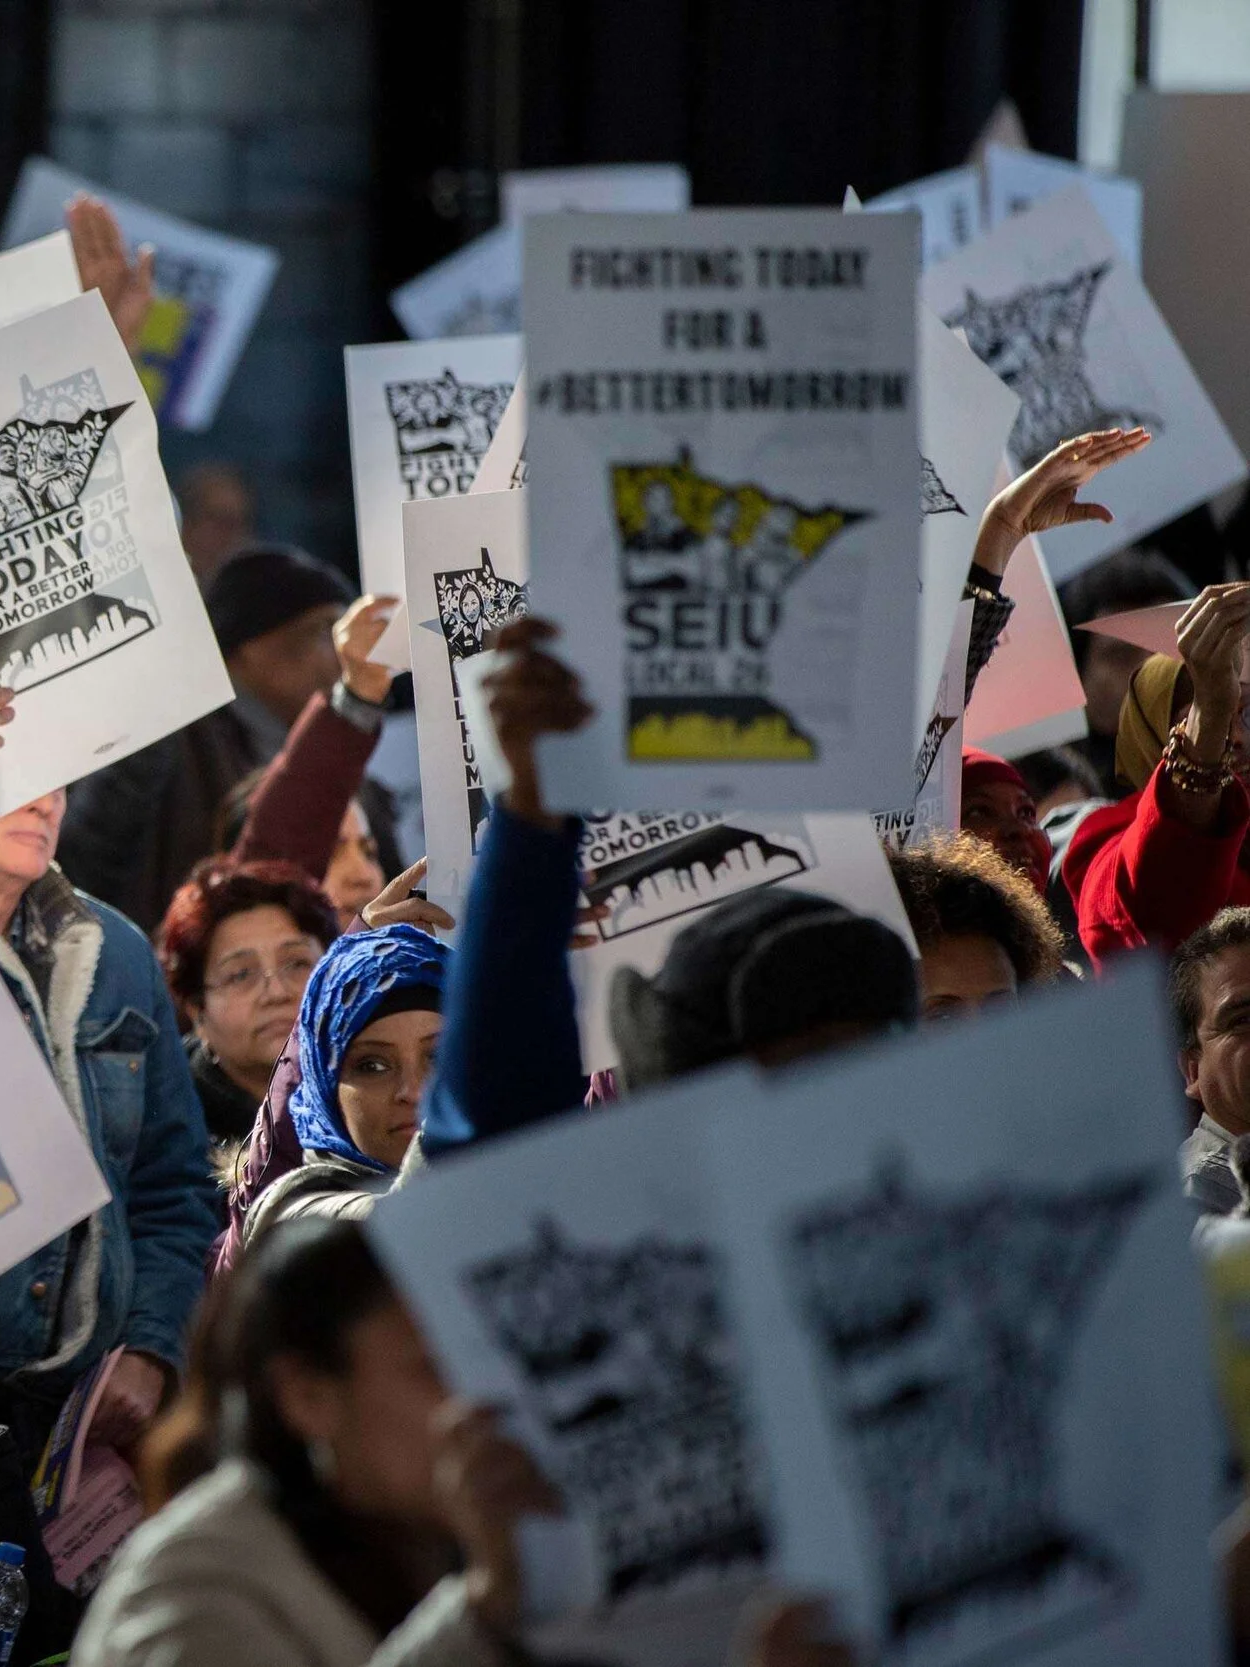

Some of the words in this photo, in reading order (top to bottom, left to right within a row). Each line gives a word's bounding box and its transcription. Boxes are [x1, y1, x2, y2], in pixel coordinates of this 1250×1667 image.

[569, 244, 744, 290] FIGHTING
[754, 244, 870, 290] TODAY
[663, 307, 734, 350] FOR
[742, 308, 767, 350] A
[536, 369, 909, 416] #BETTERTOMORROW
[13, 592, 24, 605] A
[28, 560, 91, 597] BETTER
[626, 600, 780, 652] SEIU
[581, 827, 610, 846] OR
